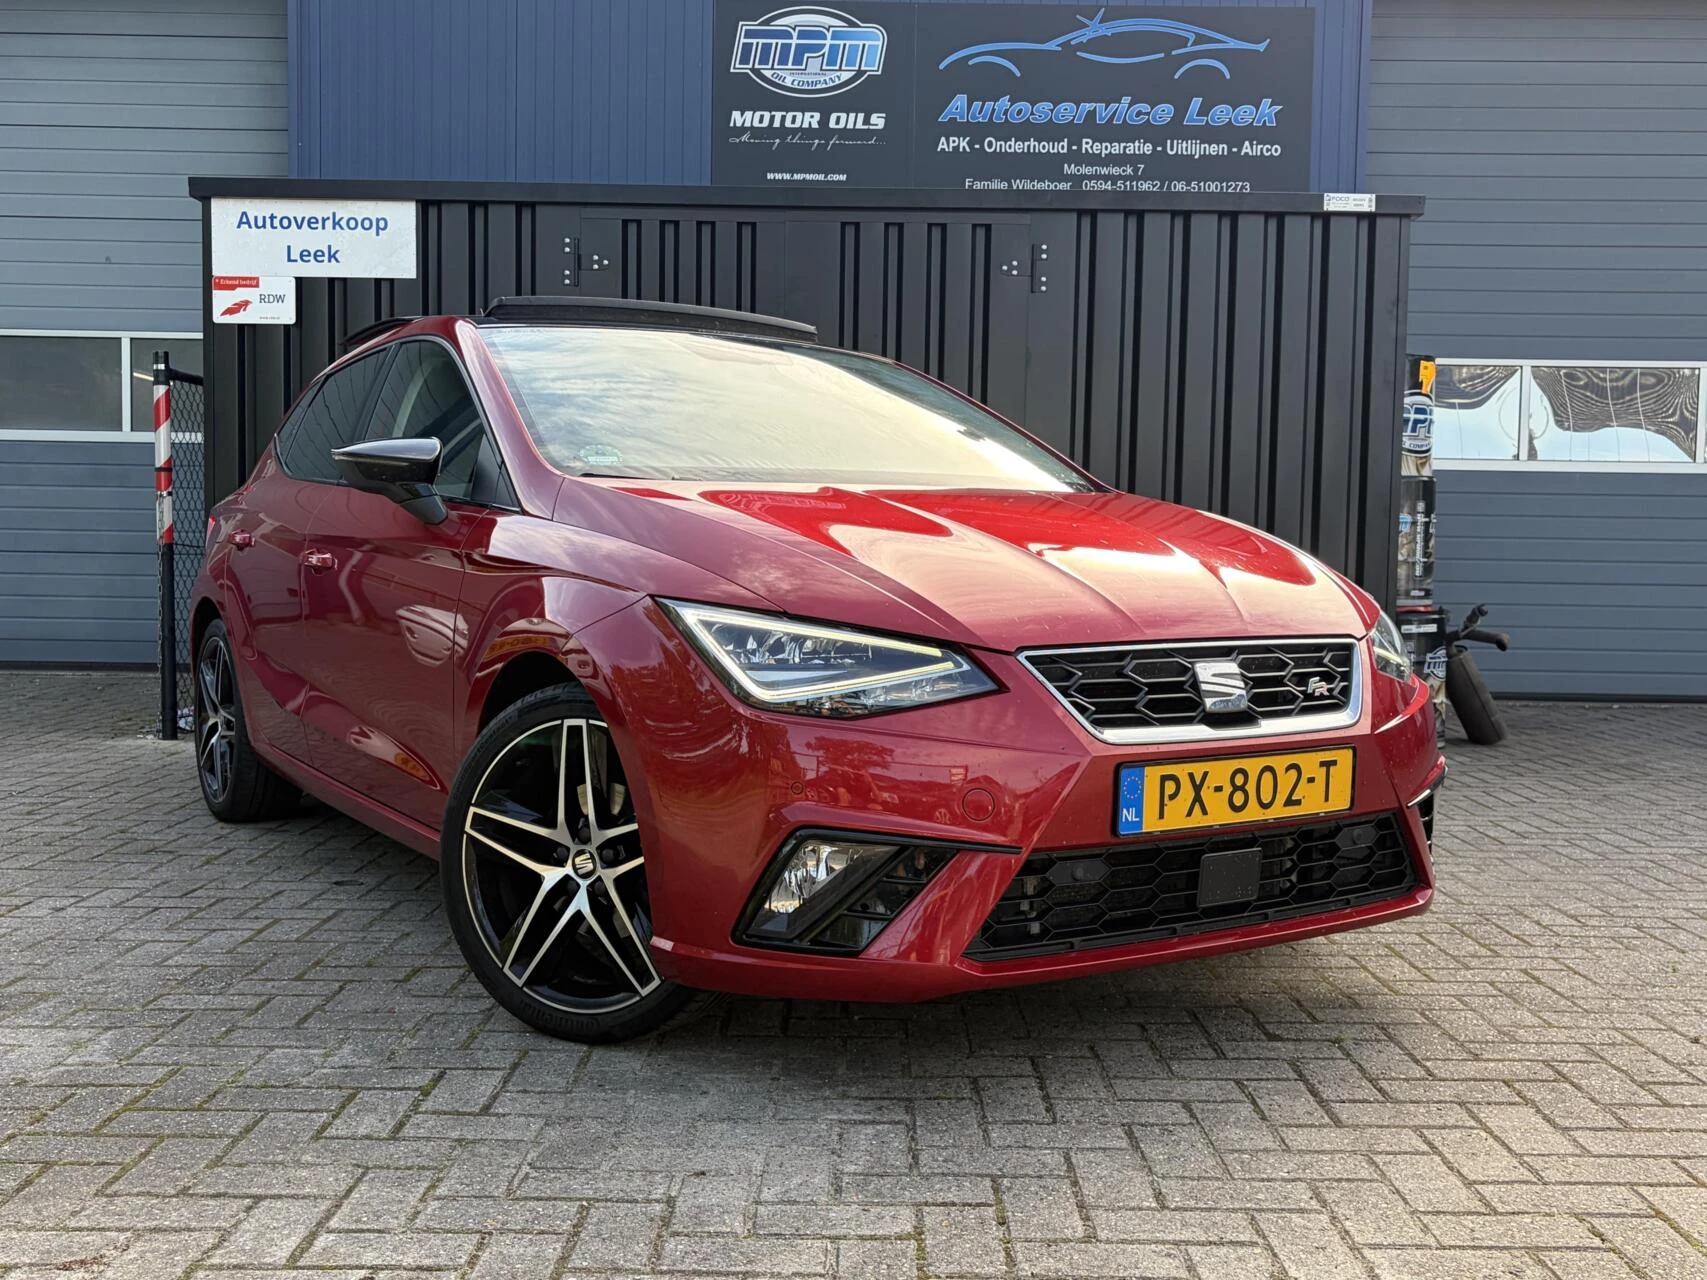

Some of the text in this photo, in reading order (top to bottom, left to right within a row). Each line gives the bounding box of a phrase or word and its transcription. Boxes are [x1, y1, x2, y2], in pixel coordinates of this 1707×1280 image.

[770, 71, 843, 88] OIL COMPANY
[729, 110, 887, 130] MOTOR OILS
[938, 94, 1284, 127] Autoservice Leek
[728, 130, 782, 150] Moving
[785, 132, 826, 151] things
[937, 136, 971, 153] APK
[983, 138, 1068, 154] Onderhoud
[1081, 138, 1153, 157] Reparatie
[1166, 140, 1229, 160] Uitlijnen
[1241, 141, 1282, 157] Airco
[1063, 163, 1145, 176] Molenwieck 7
[965, 178, 1009, 190] Familie
[1011, 178, 1072, 191] Wildeboer
[1082, 180, 1161, 192] 0594-511962
[1171, 181, 1251, 193] 06-51001273
[236, 210, 389, 237] Autoverkoop
[286, 244, 341, 264] Leek
[259, 293, 286, 304] RDW
[1307, 676, 1330, 697] FR
[1158, 759, 1338, 820] PX-802-T
[1122, 808, 1140, 823] NL
